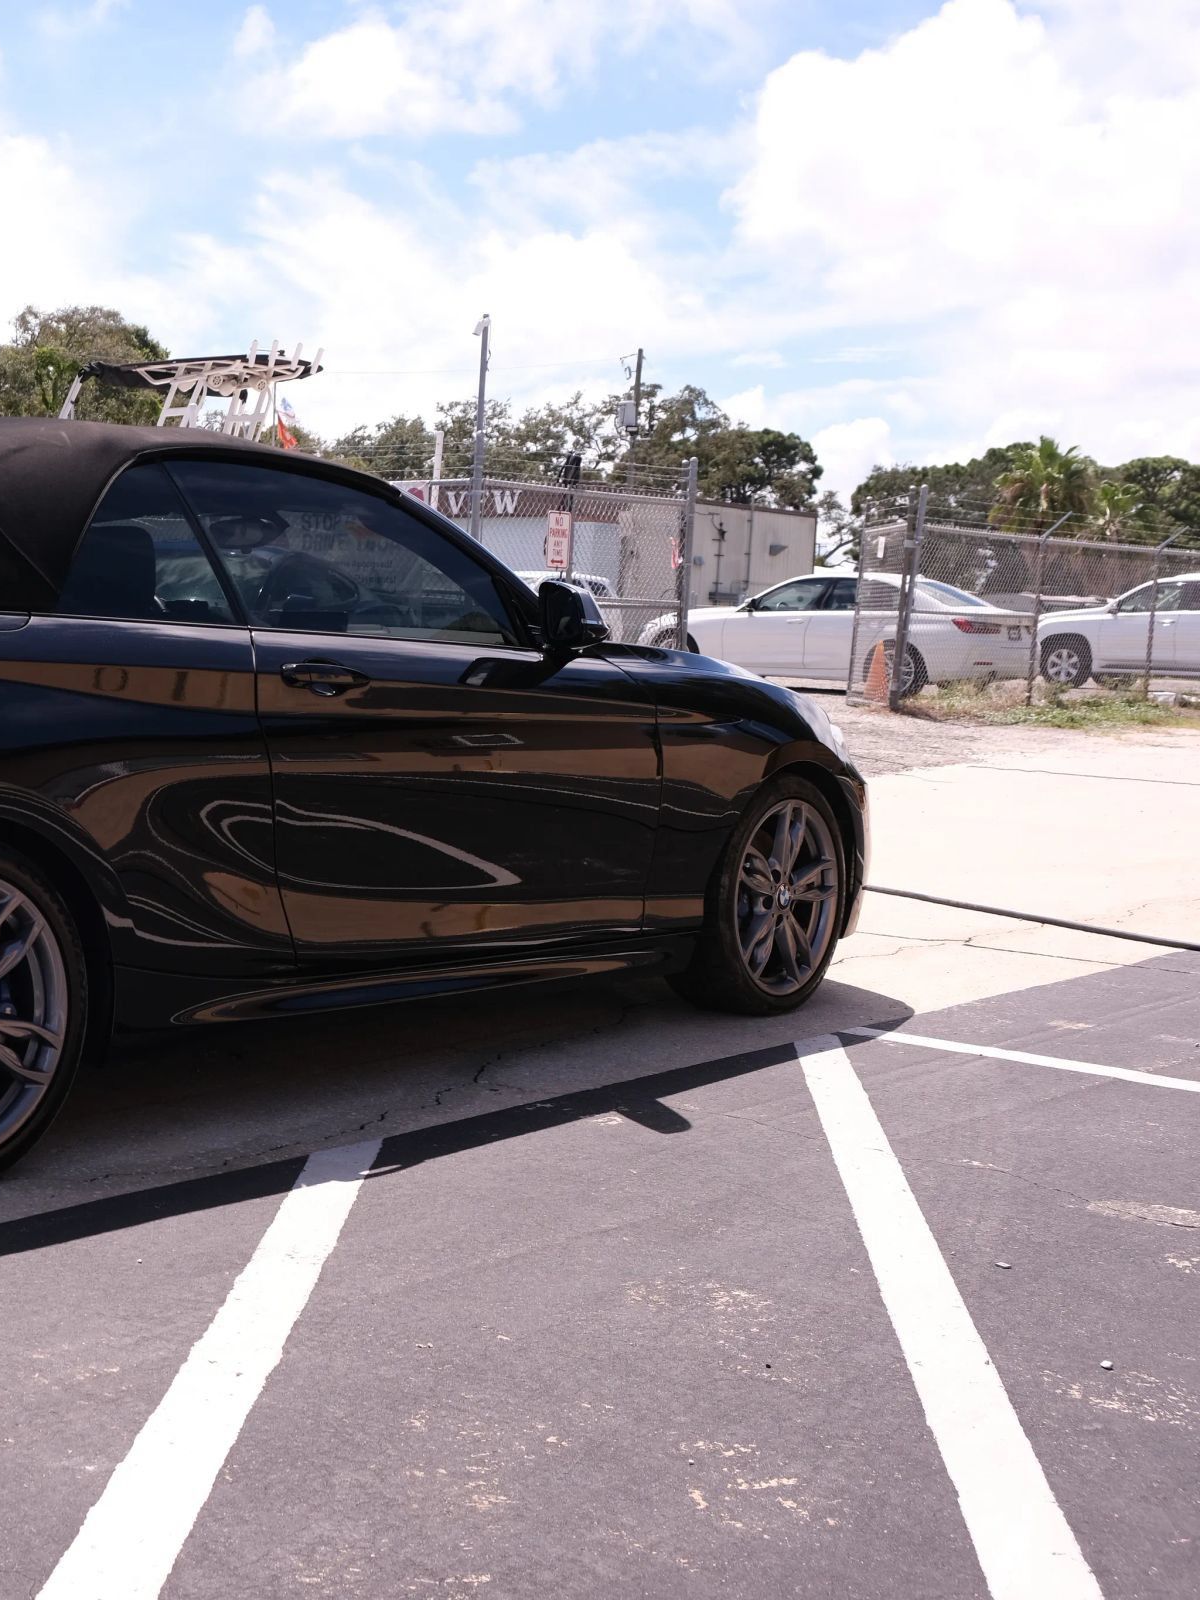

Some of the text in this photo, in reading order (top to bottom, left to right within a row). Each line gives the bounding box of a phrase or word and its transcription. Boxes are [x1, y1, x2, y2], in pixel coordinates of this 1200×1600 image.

[447, 489, 522, 515] VW
[555, 516, 564, 526] NO
[550, 527, 568, 538] PARKING
[552, 549, 563, 557] TIME
